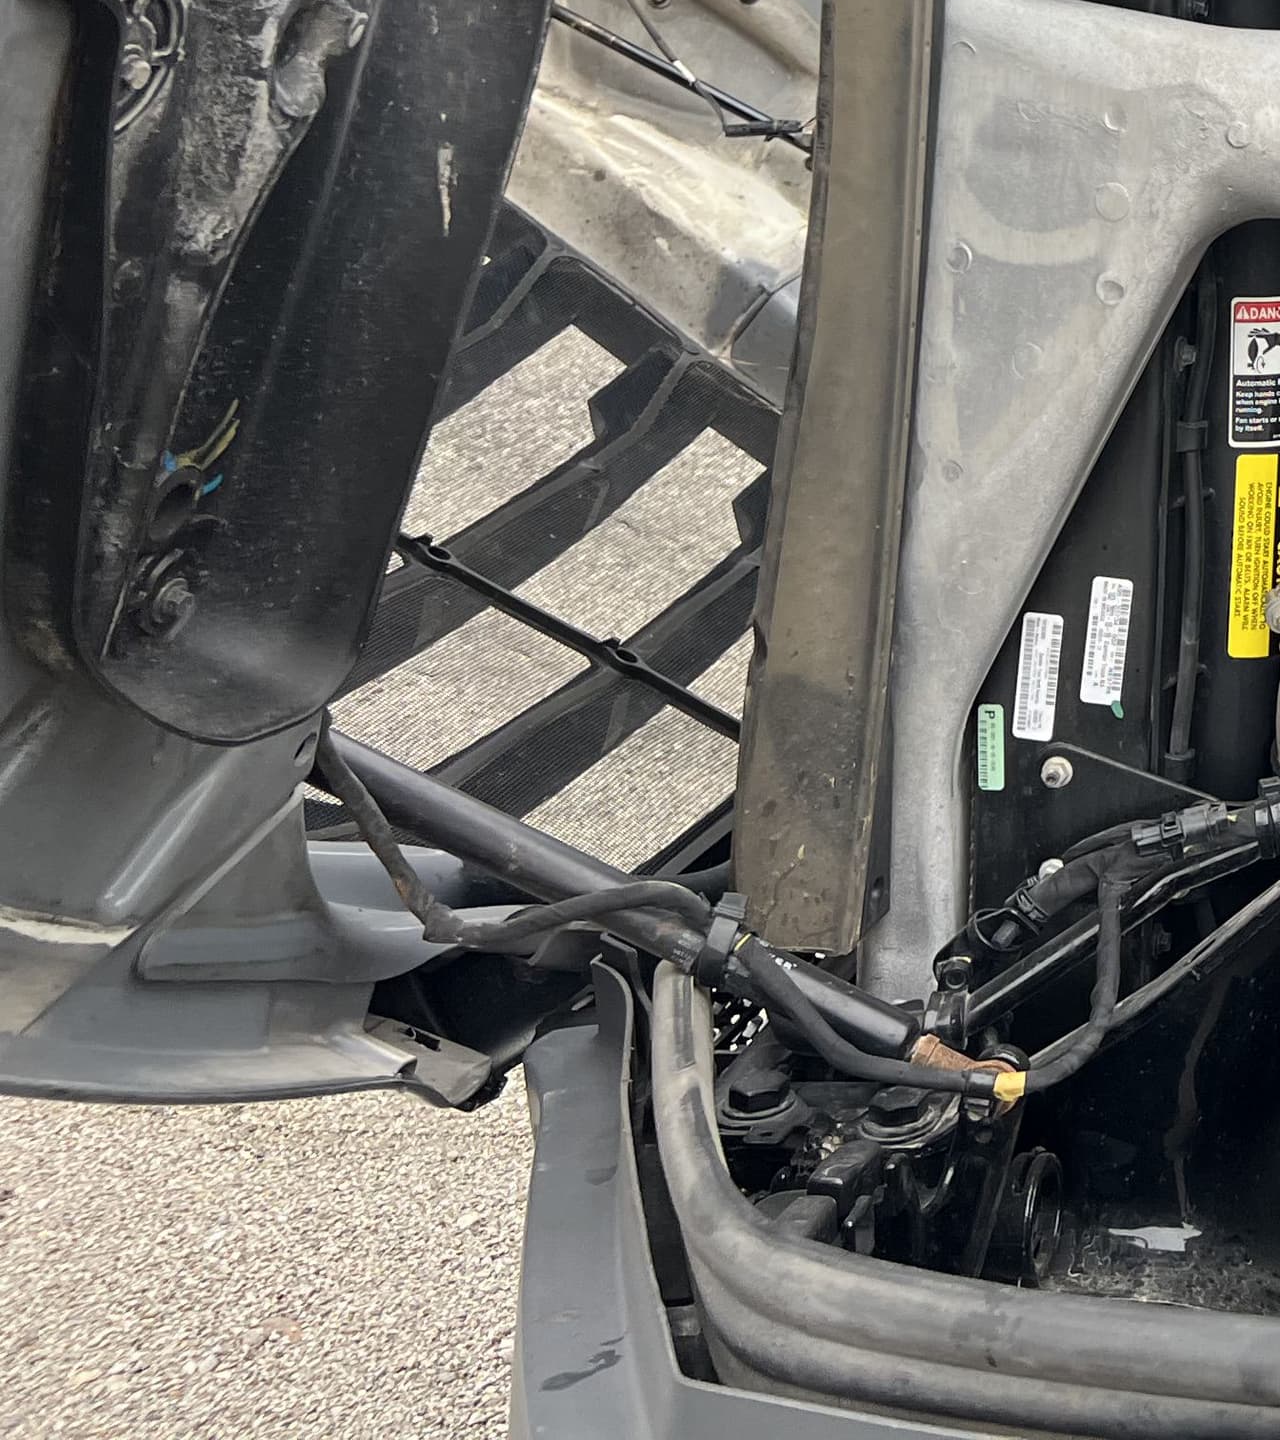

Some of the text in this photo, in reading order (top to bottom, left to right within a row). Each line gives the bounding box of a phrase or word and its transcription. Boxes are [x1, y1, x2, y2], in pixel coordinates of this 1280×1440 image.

[1236, 379, 1276, 387] Automatic
[1235, 391, 1253, 399] Keep
[1254, 390, 1275, 398] hands
[1254, 399, 1278, 407] engine
[1234, 425, 1245, 433] by
[1235, 553, 1243, 594] AUTOMATIC
[984, 710, 995, 720] P
